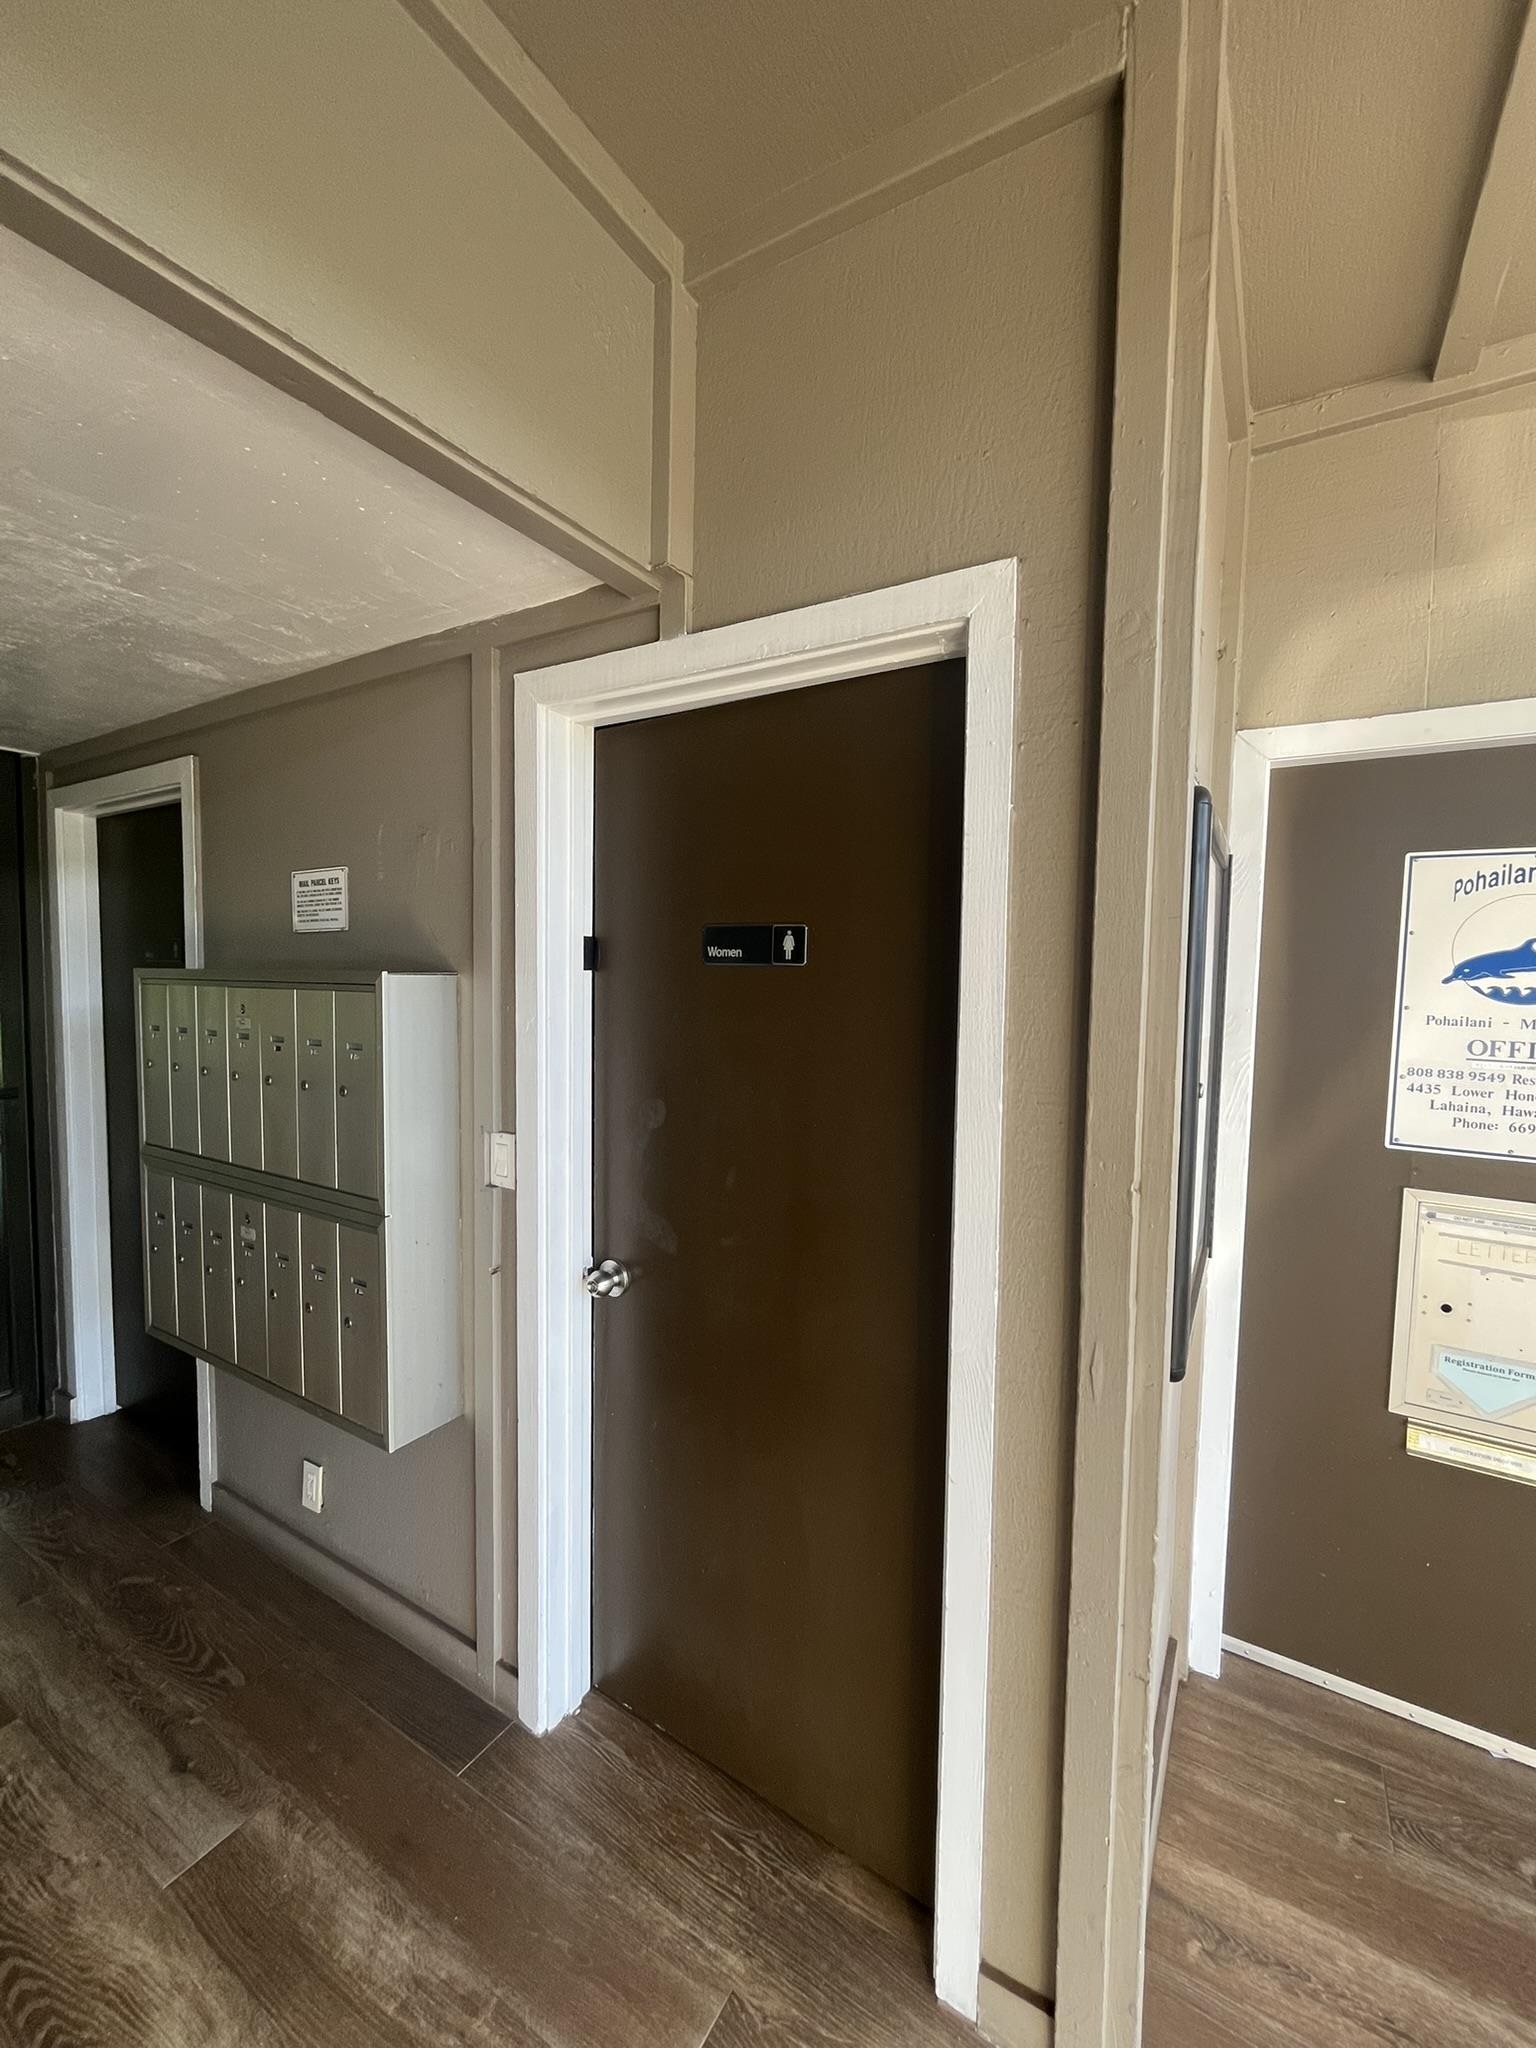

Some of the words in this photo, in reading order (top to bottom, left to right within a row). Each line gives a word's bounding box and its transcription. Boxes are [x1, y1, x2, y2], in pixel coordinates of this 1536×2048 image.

[328, 877, 340, 885] KEYS
[707, 946, 742, 957] Women
[1426, 1015, 1492, 1028] Pohailani
[1406, 1067, 1434, 1078] 808
[1437, 1069, 1465, 1080] 838
[1468, 1071, 1506, 1083] 9549
[1406, 1083, 1441, 1095] 4435
[1451, 1085, 1495, 1099] Lower
[1505, 1089, 1536, 1103] Hon
[1430, 1099, 1492, 1116] Lahaina,
[1452, 1117, 1499, 1131] Phone:
[1444, 1355, 1505, 1375] Registration
